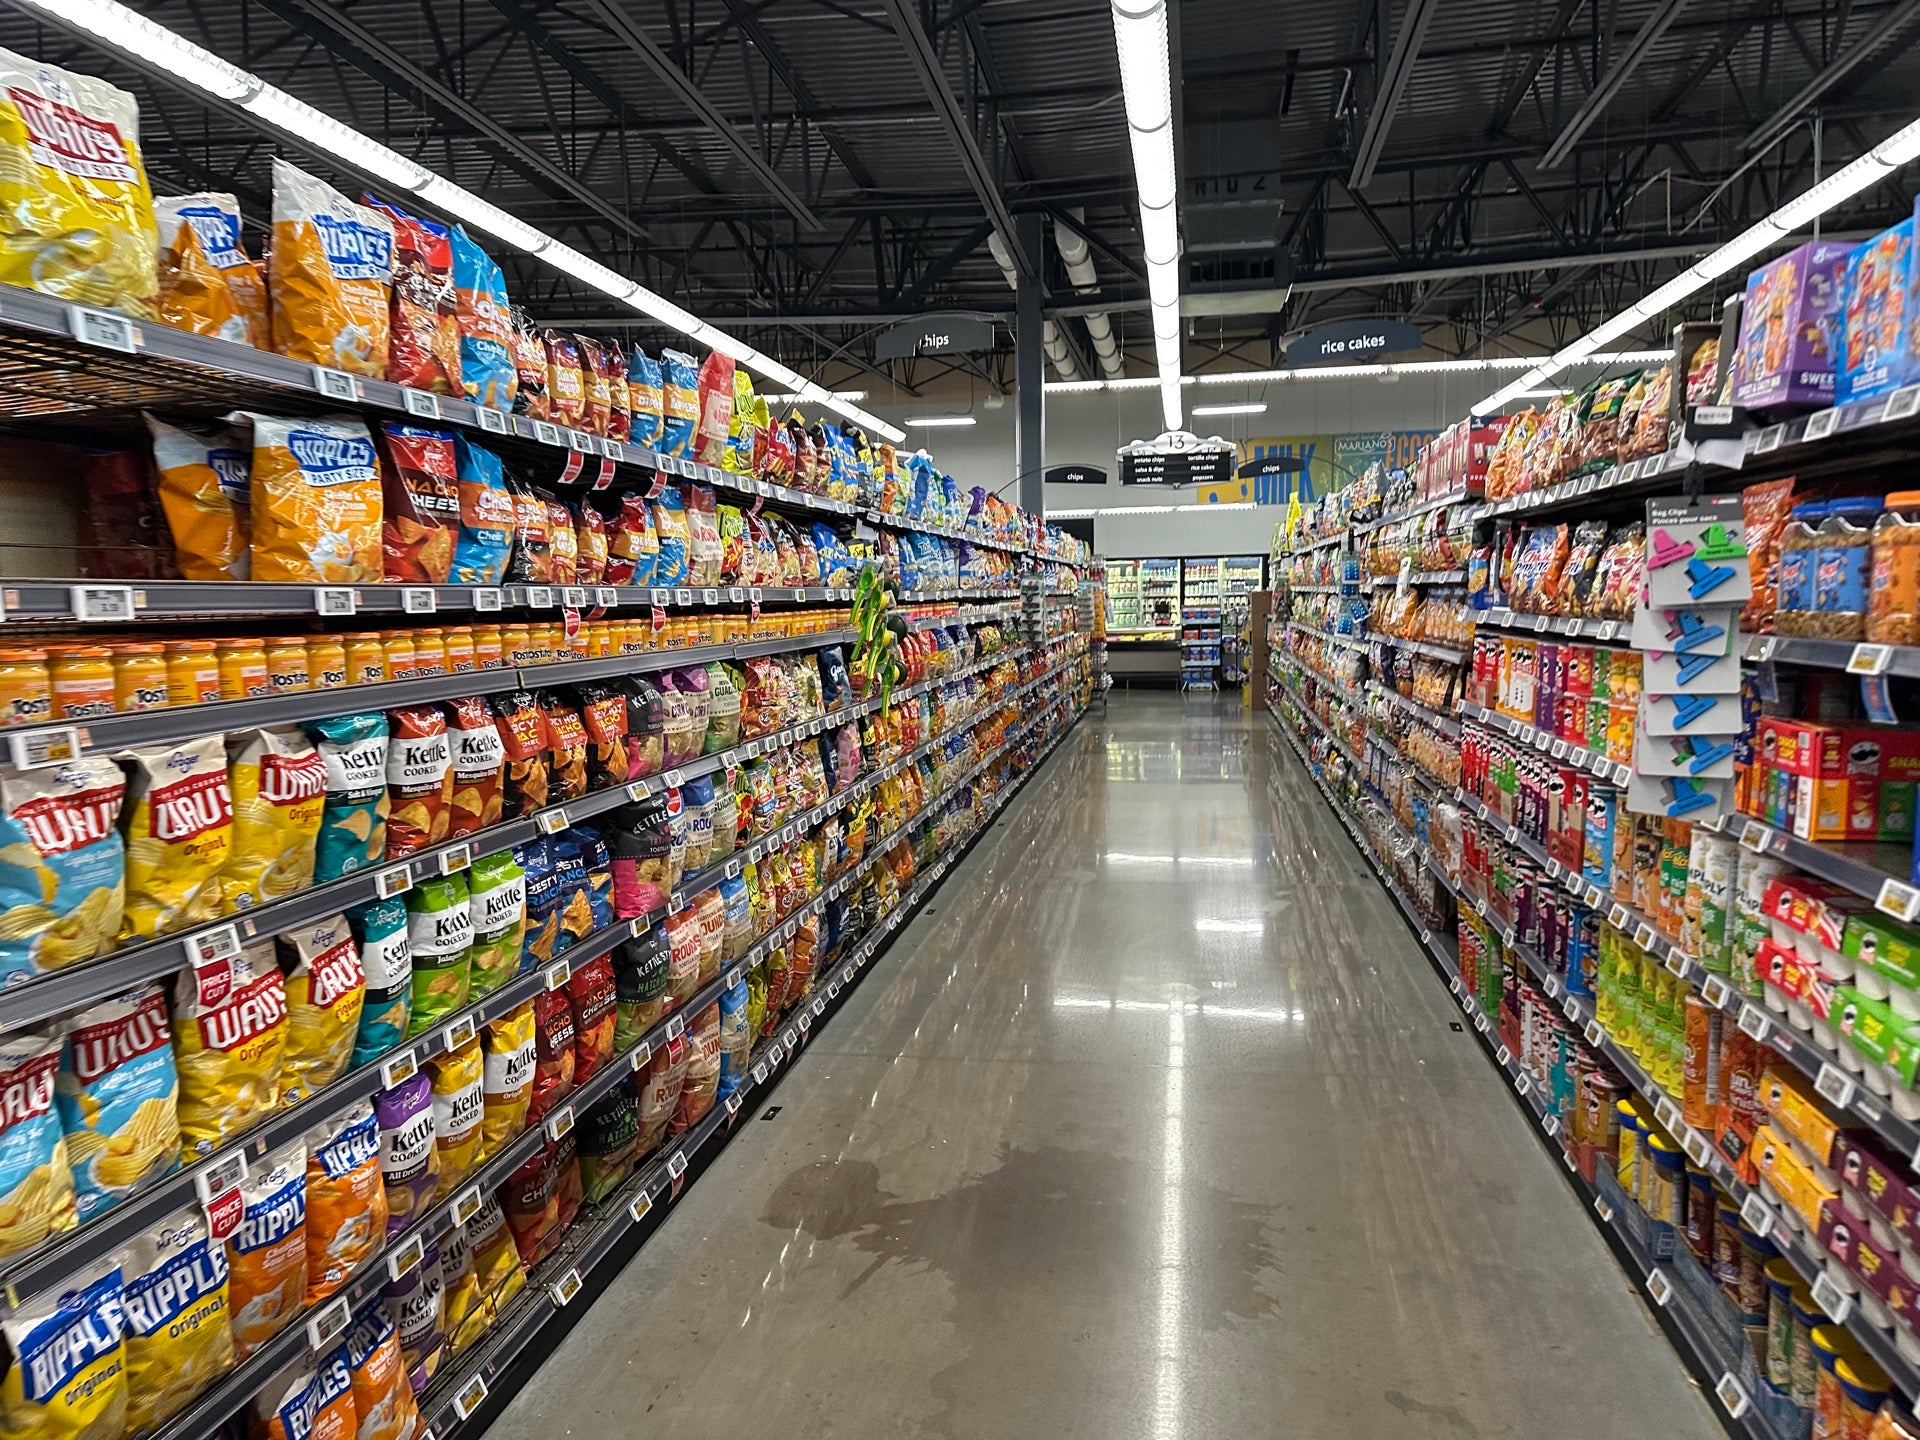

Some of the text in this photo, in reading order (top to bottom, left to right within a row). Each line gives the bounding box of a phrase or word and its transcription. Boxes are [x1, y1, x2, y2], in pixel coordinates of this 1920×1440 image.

[1321, 334, 1385, 354] rice cakes
[1800, 372, 1835, 384] SWEE
[1167, 434, 1185, 449] 13
[1338, 438, 1394, 452] MARIANO'S
[292, 439, 371, 467] RIPPLES
[1188, 454, 1204, 462] tortilla
[311, 470, 344, 484] PARTY
[1067, 472, 1084, 481] chips
[1254, 442, 1317, 505] MILK
[1262, 464, 1280, 473] chips
[1668, 508, 1687, 516] Clips
[556, 723, 582, 734] ACHO
[461, 734, 499, 754] Kettle
[166, 752, 199, 774] Kroger
[405, 744, 448, 766] Kettle
[457, 770, 487, 780] Mesquite
[632, 811, 668, 835] KETTLE
[528, 874, 557, 895] ZESTY
[486, 888, 522, 916] Kettle
[435, 912, 471, 938] Kttl
[202, 971, 230, 990] PRICE
[206, 985, 226, 1000] CUT
[586, 984, 615, 1006] NACHO
[336, 993, 362, 1021] riginal
[583, 990, 617, 1019] CHEESE
[549, 1024, 575, 1048] EESE
[452, 1086, 483, 1119] Kettl
[450, 1108, 479, 1128] COOKED
[392, 1116, 435, 1152] Kettle
[390, 1143, 425, 1163] COOKED
[388, 1169, 403, 1181] All
[212, 1197, 241, 1222] PRICE
[217, 1213, 237, 1232] CUT
[238, 1190, 306, 1251] RIPPL
[469, 1214, 499, 1238] COOKED
[157, 1222, 197, 1249] Kroger
[169, 1295, 226, 1339] Original
[370, 1366, 387, 1381] Sour
[288, 1360, 351, 1440] RILES
